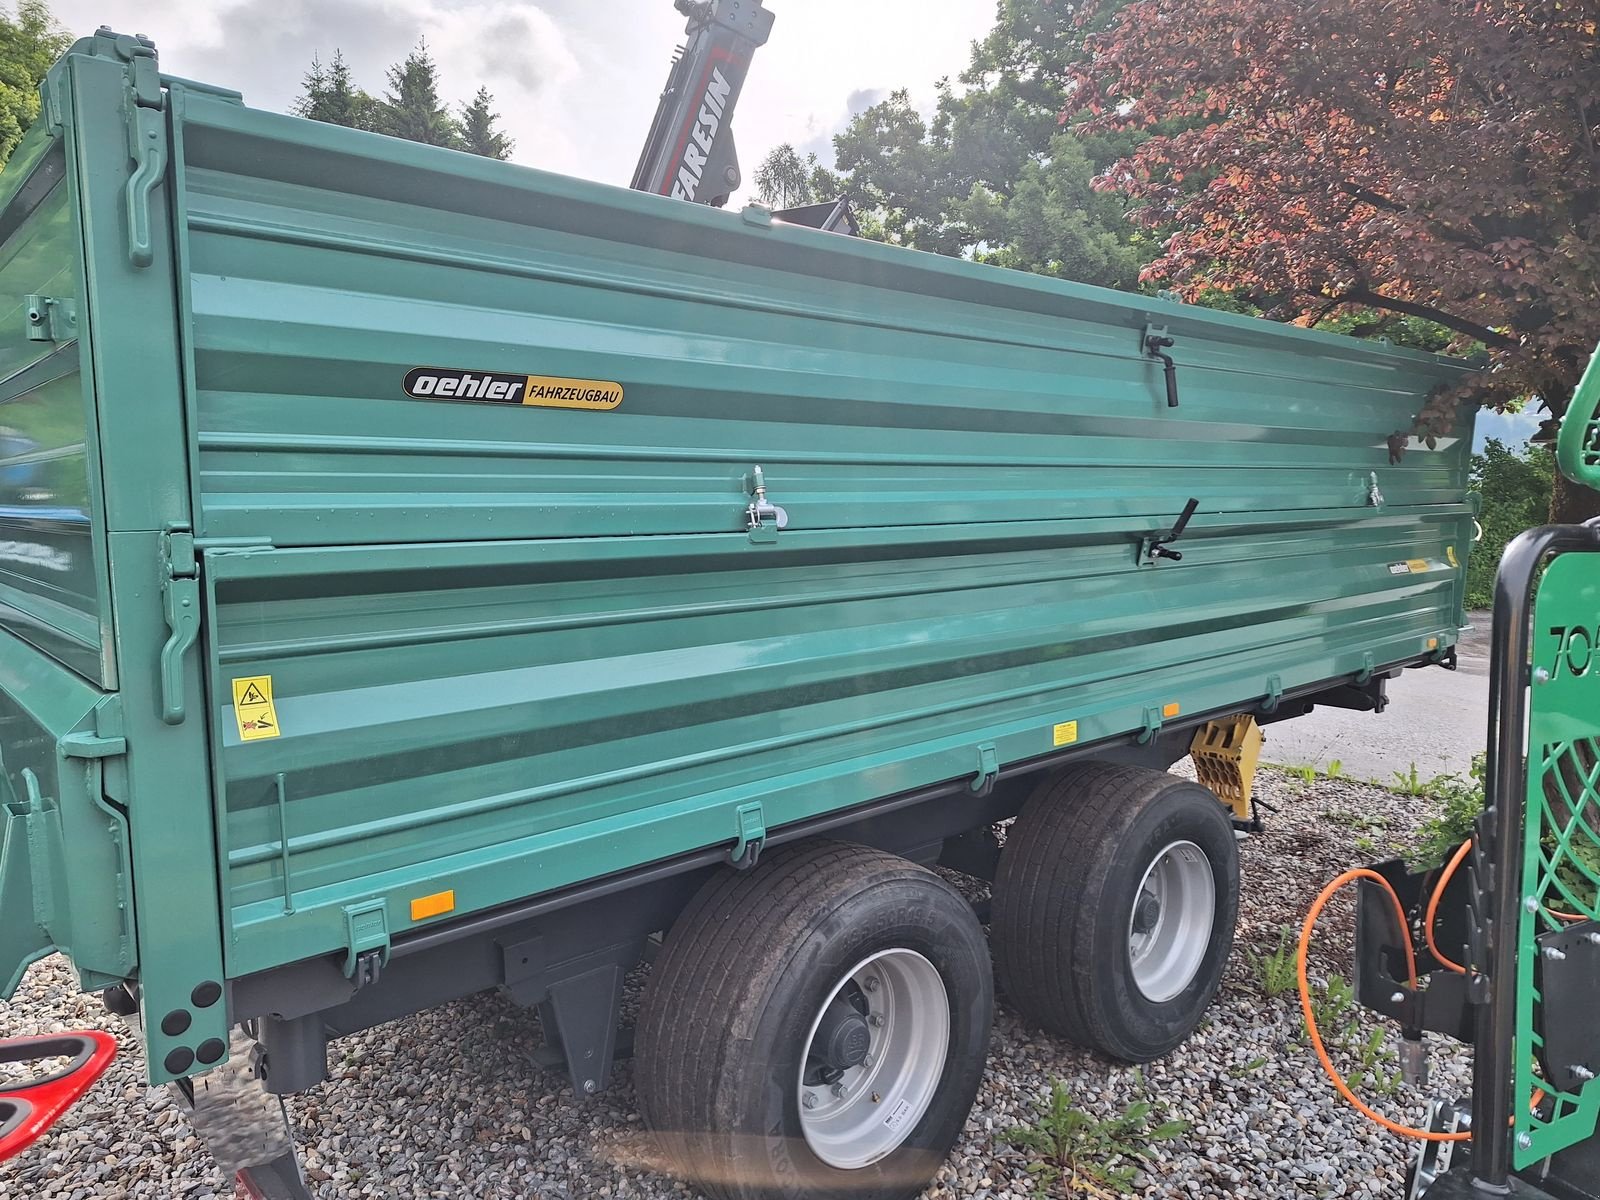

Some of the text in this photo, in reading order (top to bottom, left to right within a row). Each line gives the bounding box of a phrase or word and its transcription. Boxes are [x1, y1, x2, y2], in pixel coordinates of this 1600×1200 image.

[670, 66, 731, 201] FARESIN
[412, 374, 619, 404] oehler FAHRZEUGBAU
